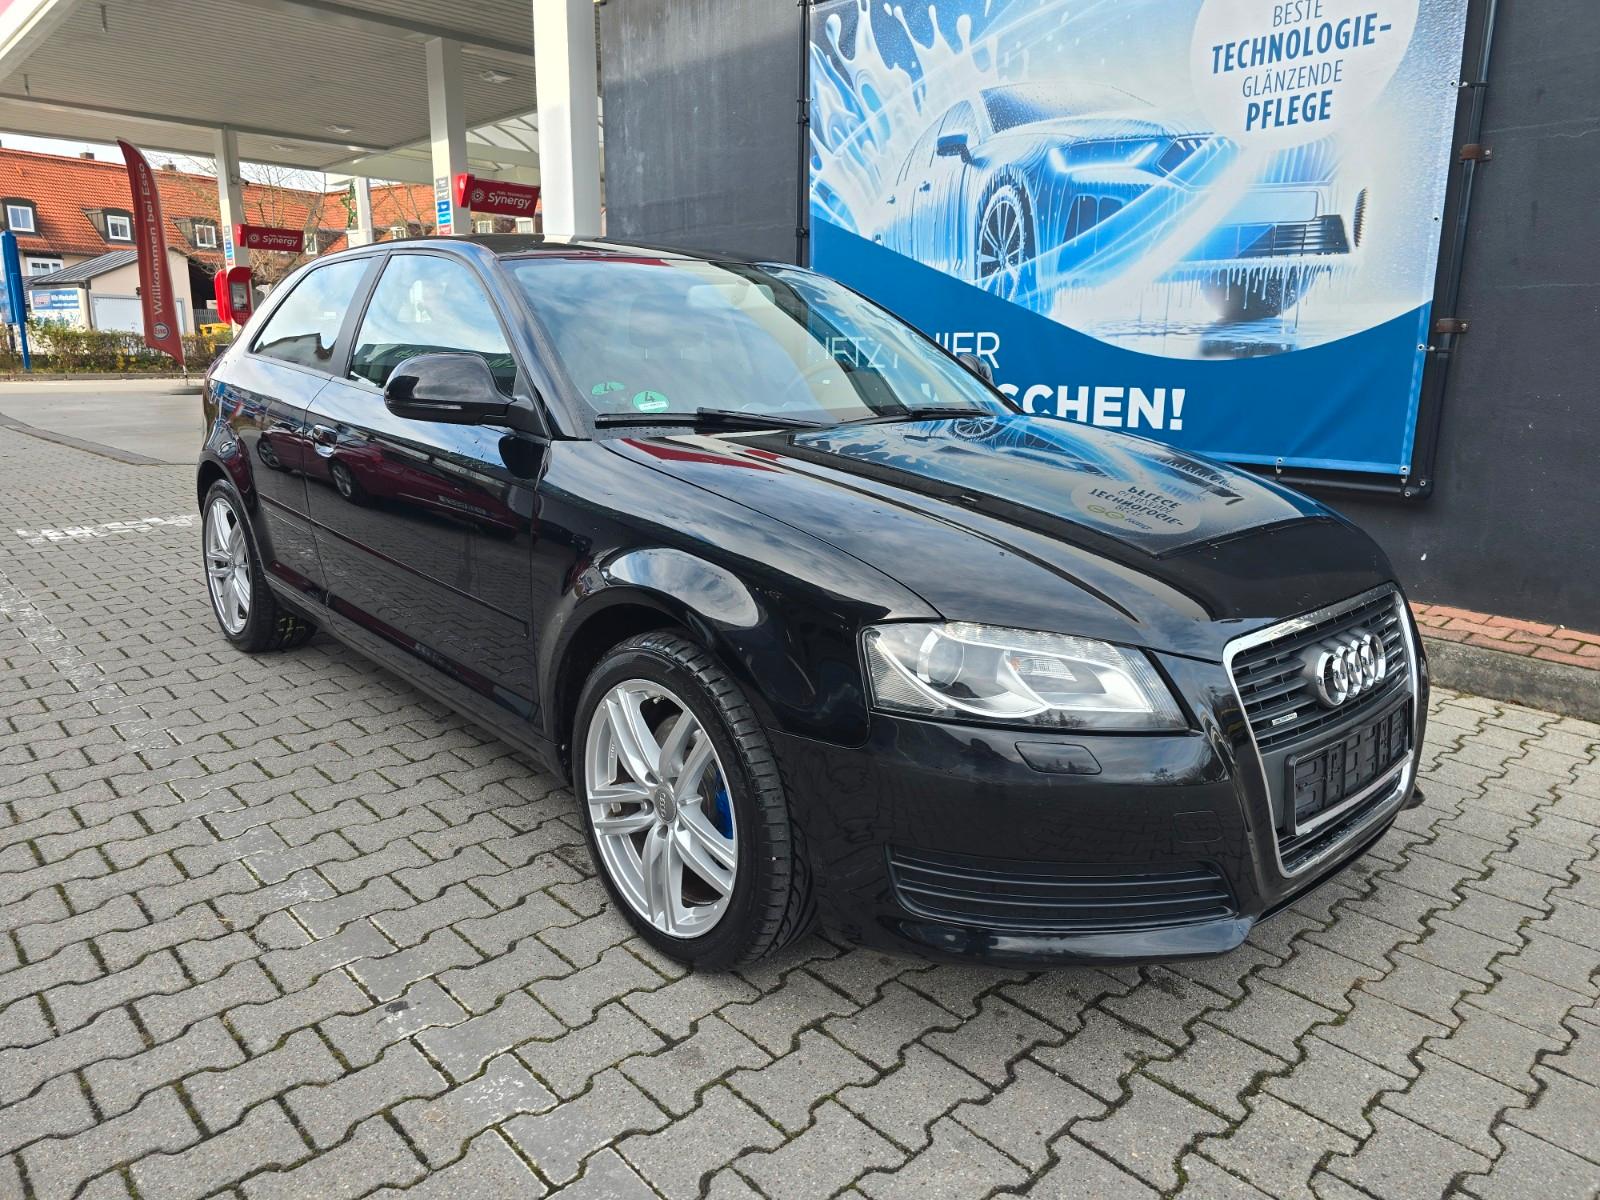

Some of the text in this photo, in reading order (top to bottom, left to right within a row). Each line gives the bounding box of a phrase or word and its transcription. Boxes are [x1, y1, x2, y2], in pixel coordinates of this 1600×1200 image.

[1273, 0, 1323, 27] BESTE
[1212, 12, 1392, 74] TECHNOLOGIE-
[1242, 59, 1344, 98] GLÄNZENDE
[1245, 89, 1333, 131] PFLEGE
[488, 192, 531, 209] Synergy
[138, 162, 163, 315] Willkommen bei Esso
[262, 235, 298, 247] Synergy
